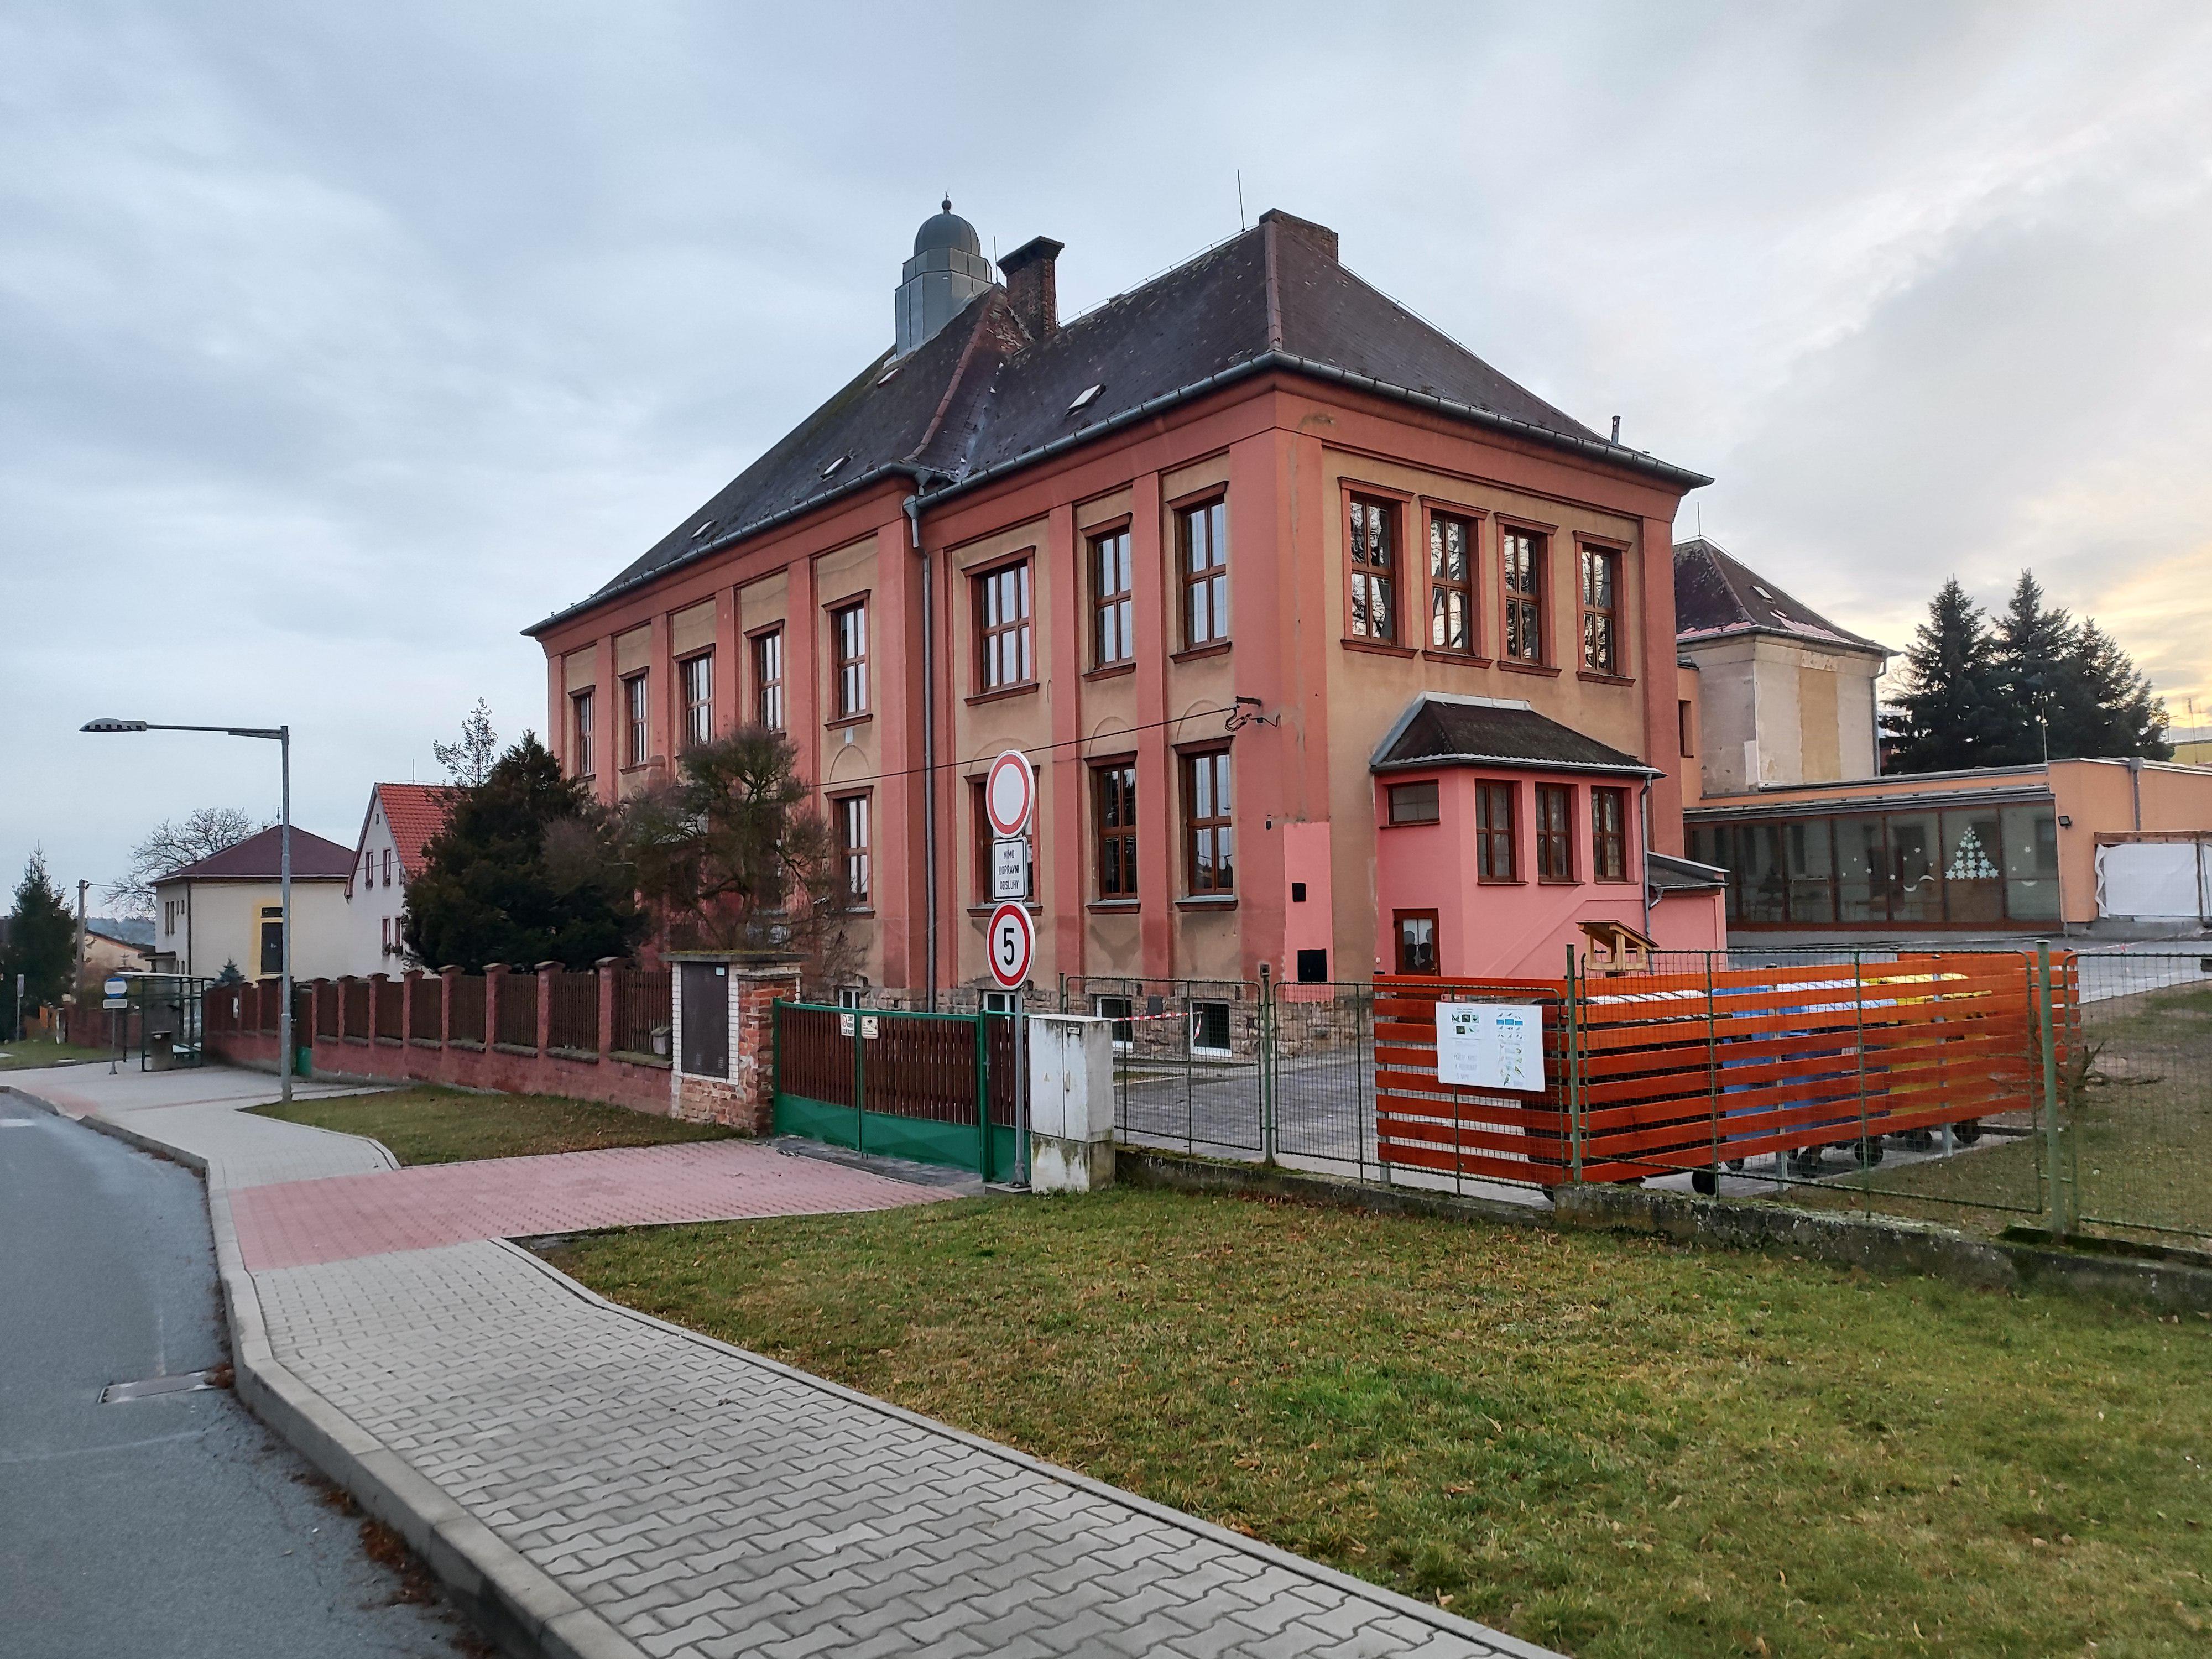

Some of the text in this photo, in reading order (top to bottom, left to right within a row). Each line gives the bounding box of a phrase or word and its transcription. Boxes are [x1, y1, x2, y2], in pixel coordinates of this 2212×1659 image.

[1003, 850, 1015, 859] MIMO
[999, 863, 1019, 875] DOPRAVNÍ
[999, 880, 1019, 890] OBSLUHY
[1004, 928, 1014, 966] 5
